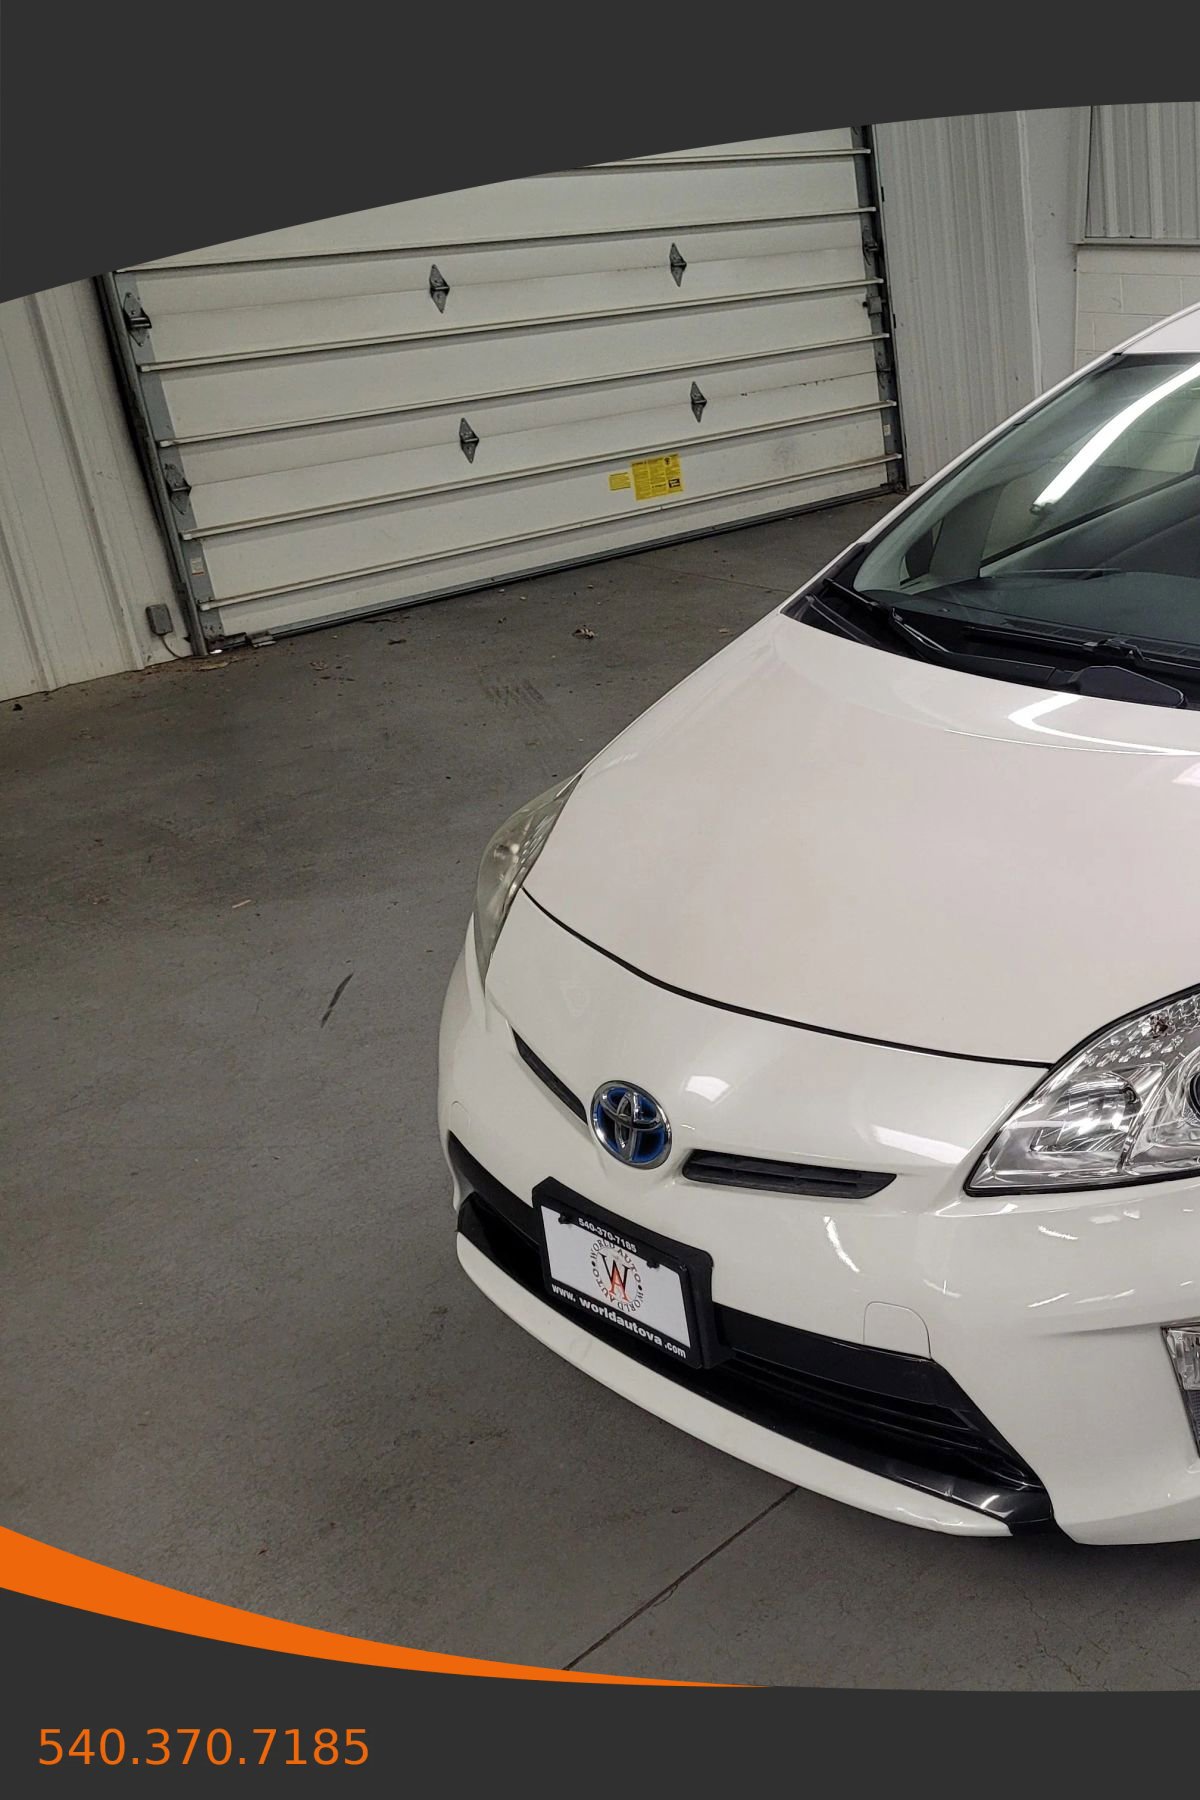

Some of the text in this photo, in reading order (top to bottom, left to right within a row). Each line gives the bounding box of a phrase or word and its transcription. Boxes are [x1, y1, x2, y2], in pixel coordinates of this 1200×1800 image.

[578, 1217, 637, 1254] 540-370-7185
[617, 1248, 642, 1283] AUTO
[592, 1268, 616, 1303] AUTO
